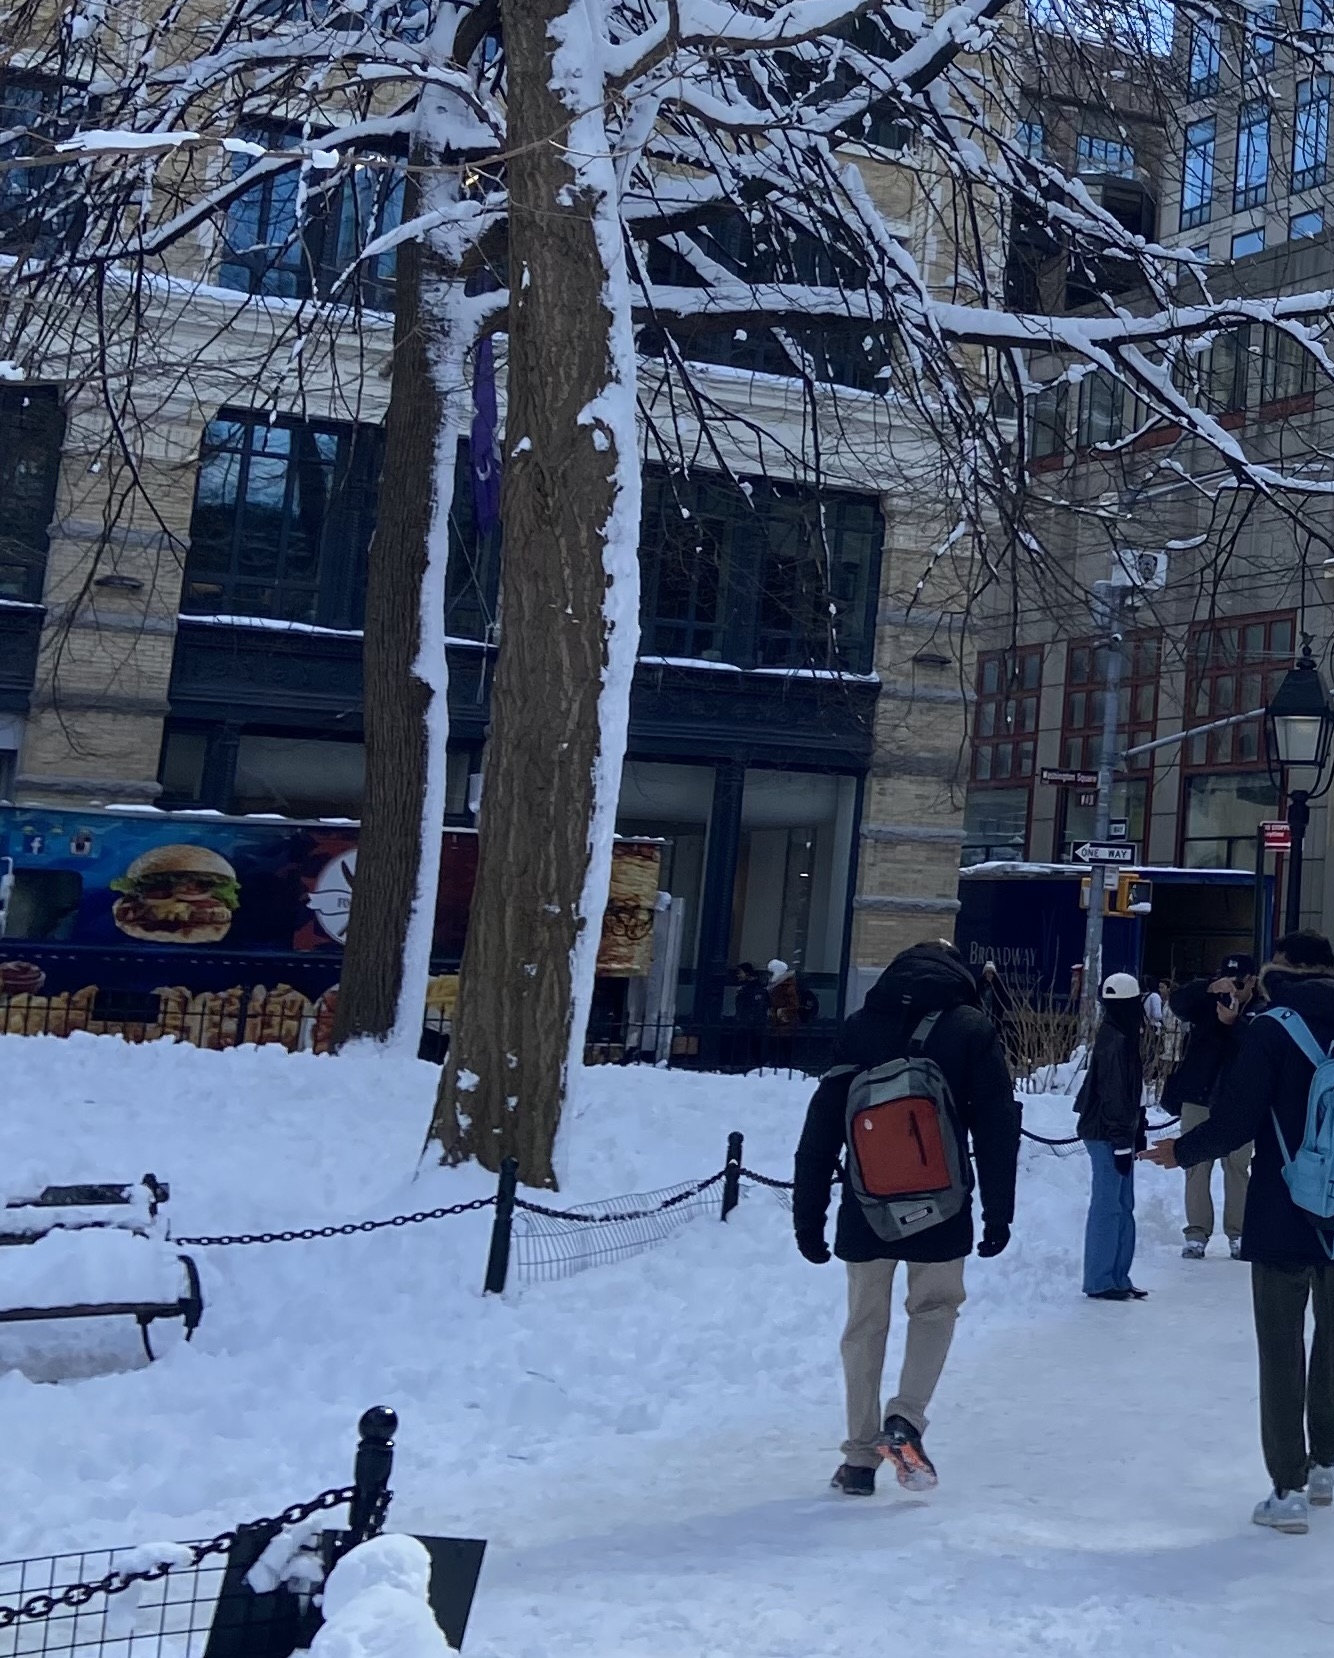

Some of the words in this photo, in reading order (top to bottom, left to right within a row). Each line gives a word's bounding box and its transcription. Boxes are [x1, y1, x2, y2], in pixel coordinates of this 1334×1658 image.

[1081, 847, 1099, 859] ONE
[1108, 849, 1127, 859] WAY
[969, 940, 1037, 967] BROADWAY
